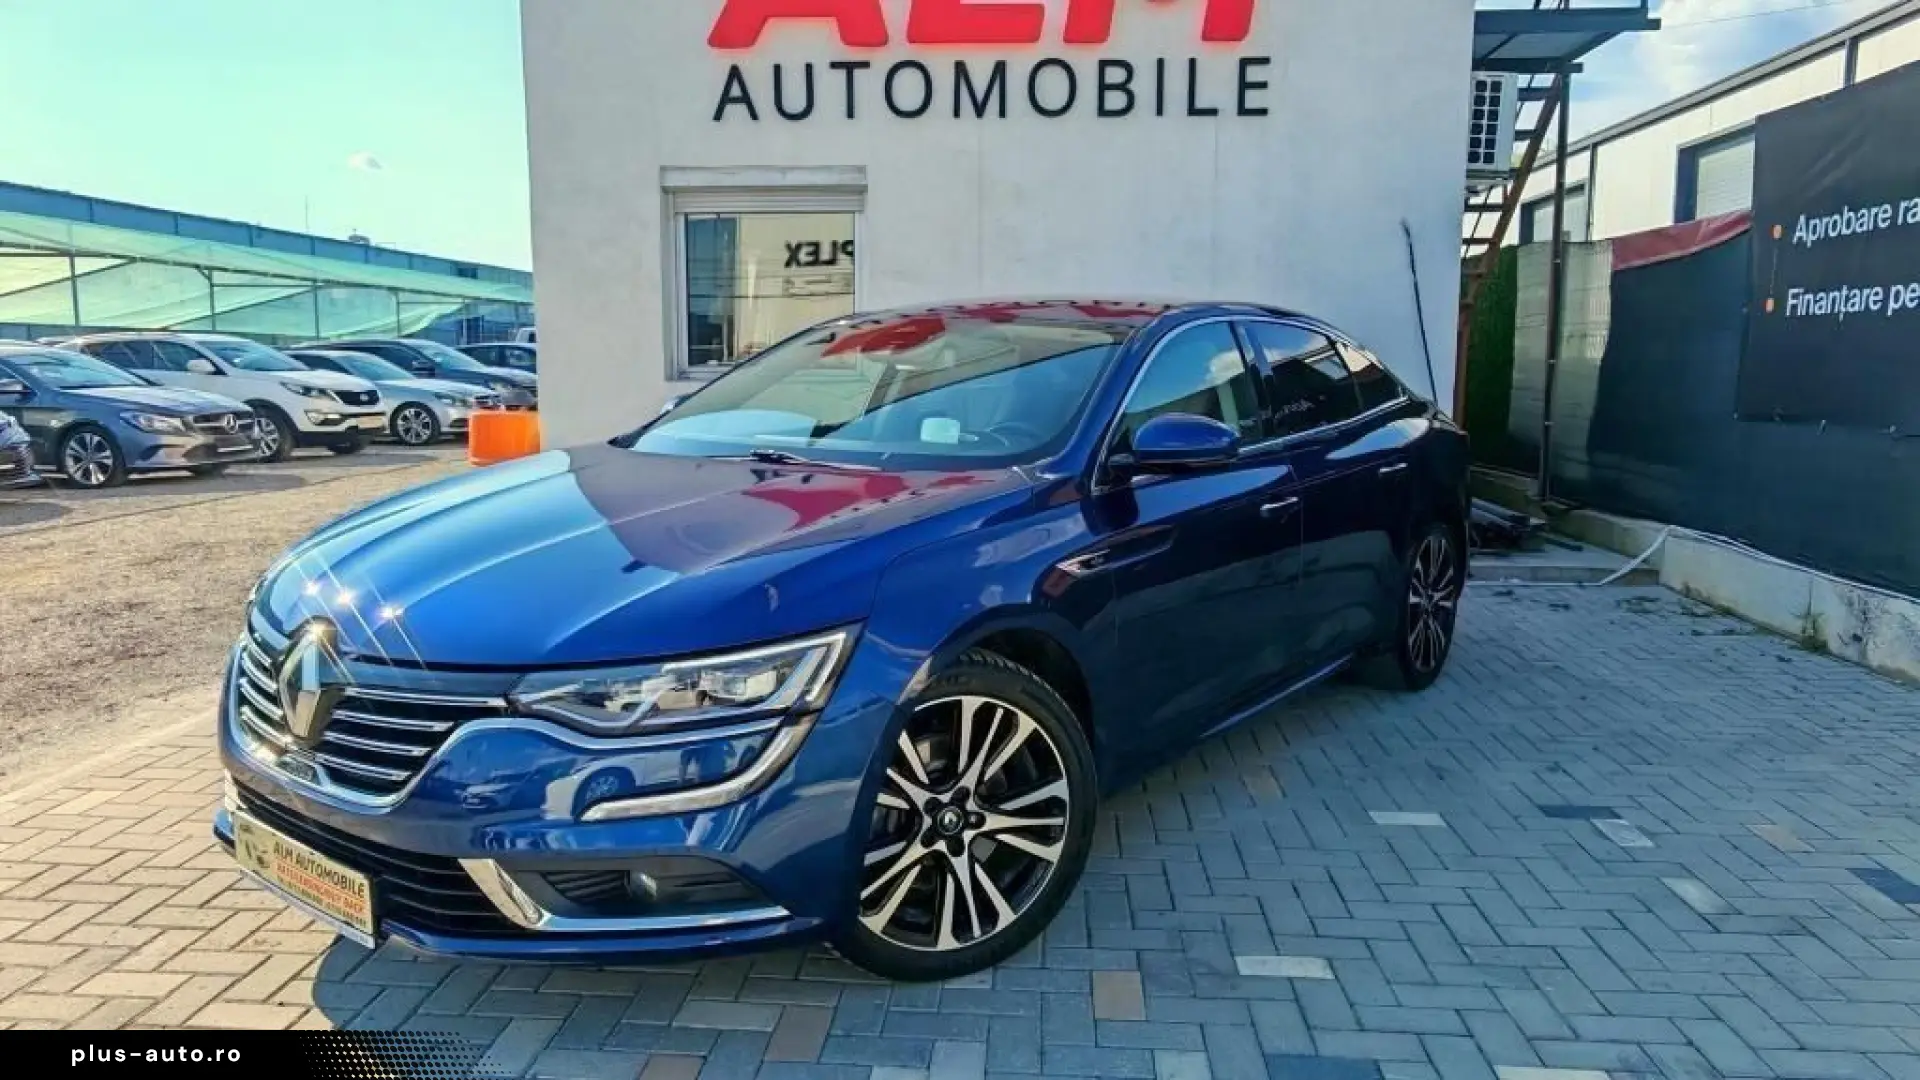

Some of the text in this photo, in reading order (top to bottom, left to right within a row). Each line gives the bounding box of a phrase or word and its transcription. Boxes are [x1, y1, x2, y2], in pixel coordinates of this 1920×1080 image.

[713, 56, 1271, 121] AUTOMOBILE
[1792, 204, 1892, 248] Aprobare
[1786, 283, 1920, 323] Finanțare pe
[295, 852, 365, 899] AUTOMOBILE
